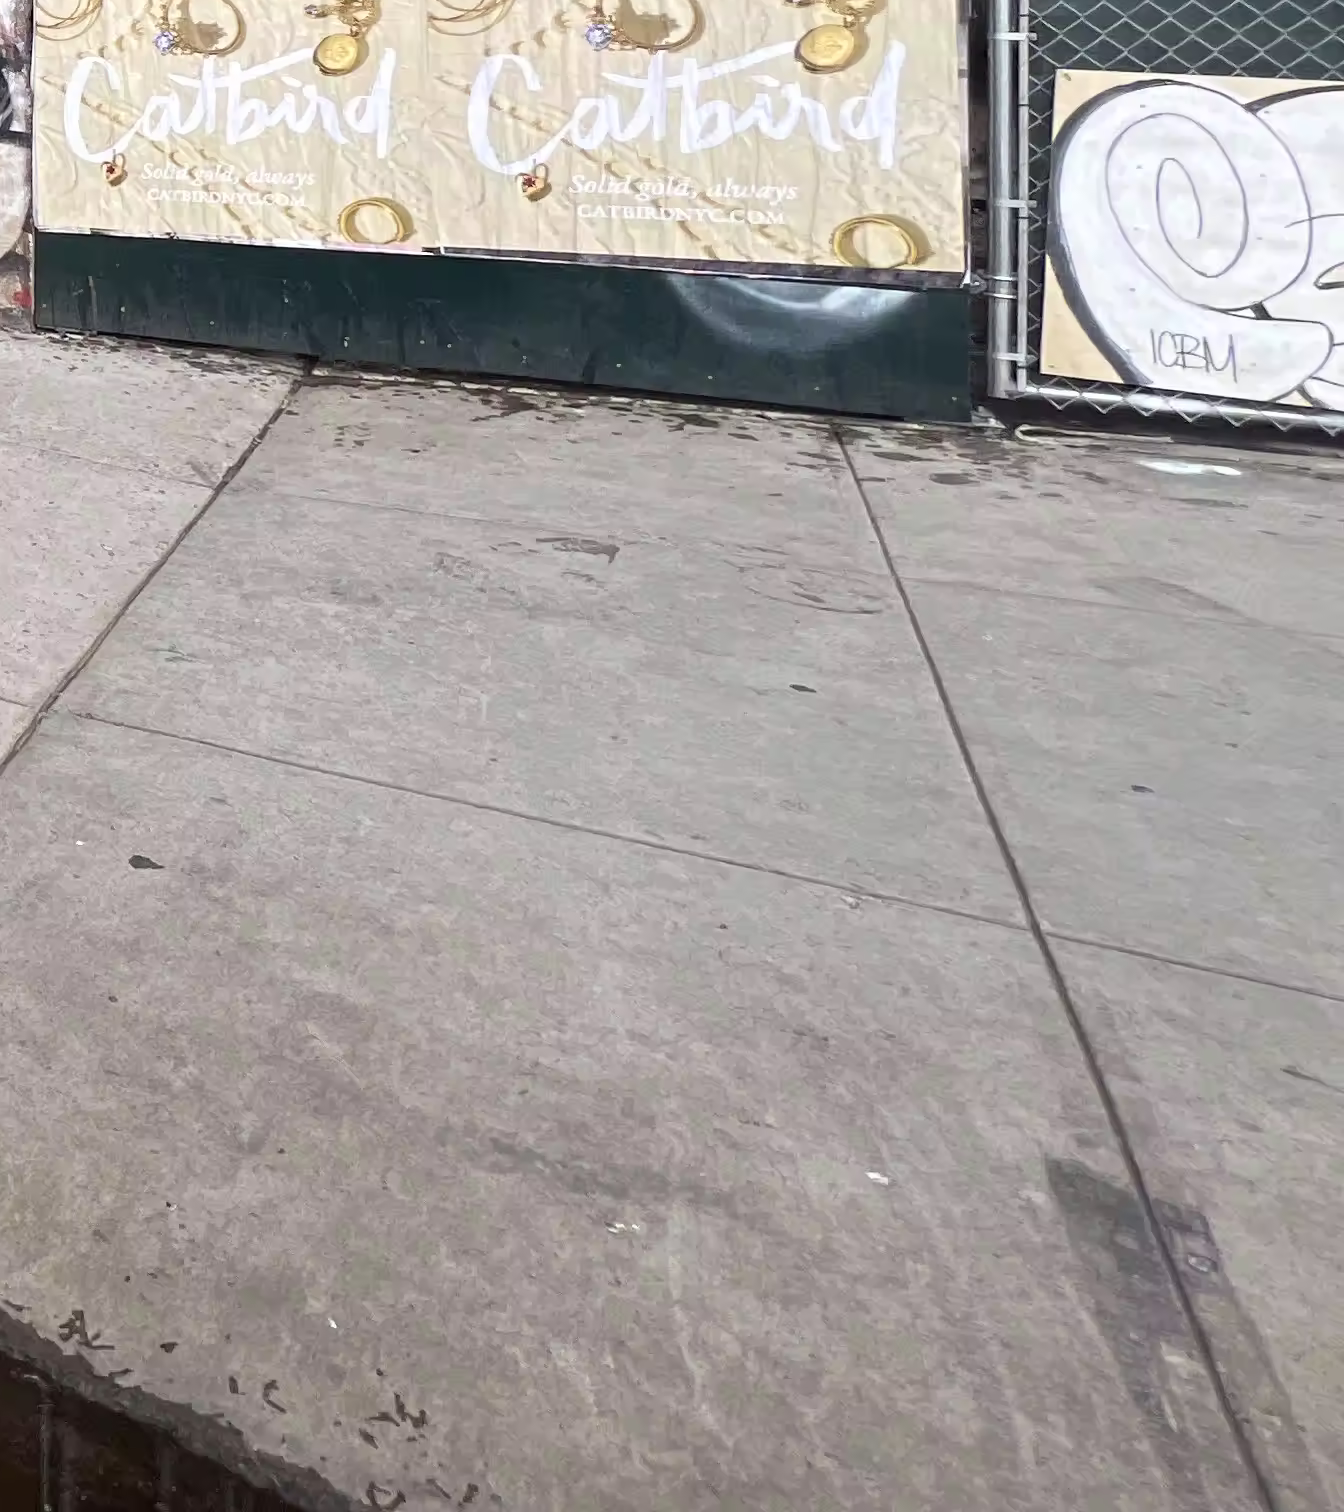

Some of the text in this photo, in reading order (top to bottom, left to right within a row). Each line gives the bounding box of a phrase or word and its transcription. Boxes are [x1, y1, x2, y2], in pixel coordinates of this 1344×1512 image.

[64, 47, 396, 163] Catbird
[467, 40, 906, 175] Catbird
[141, 162, 188, 181] Solid
[245, 165, 317, 190] always
[568, 175, 799, 206] Solid gold, always
[577, 204, 786, 226] CATBIRDNYC.COM
